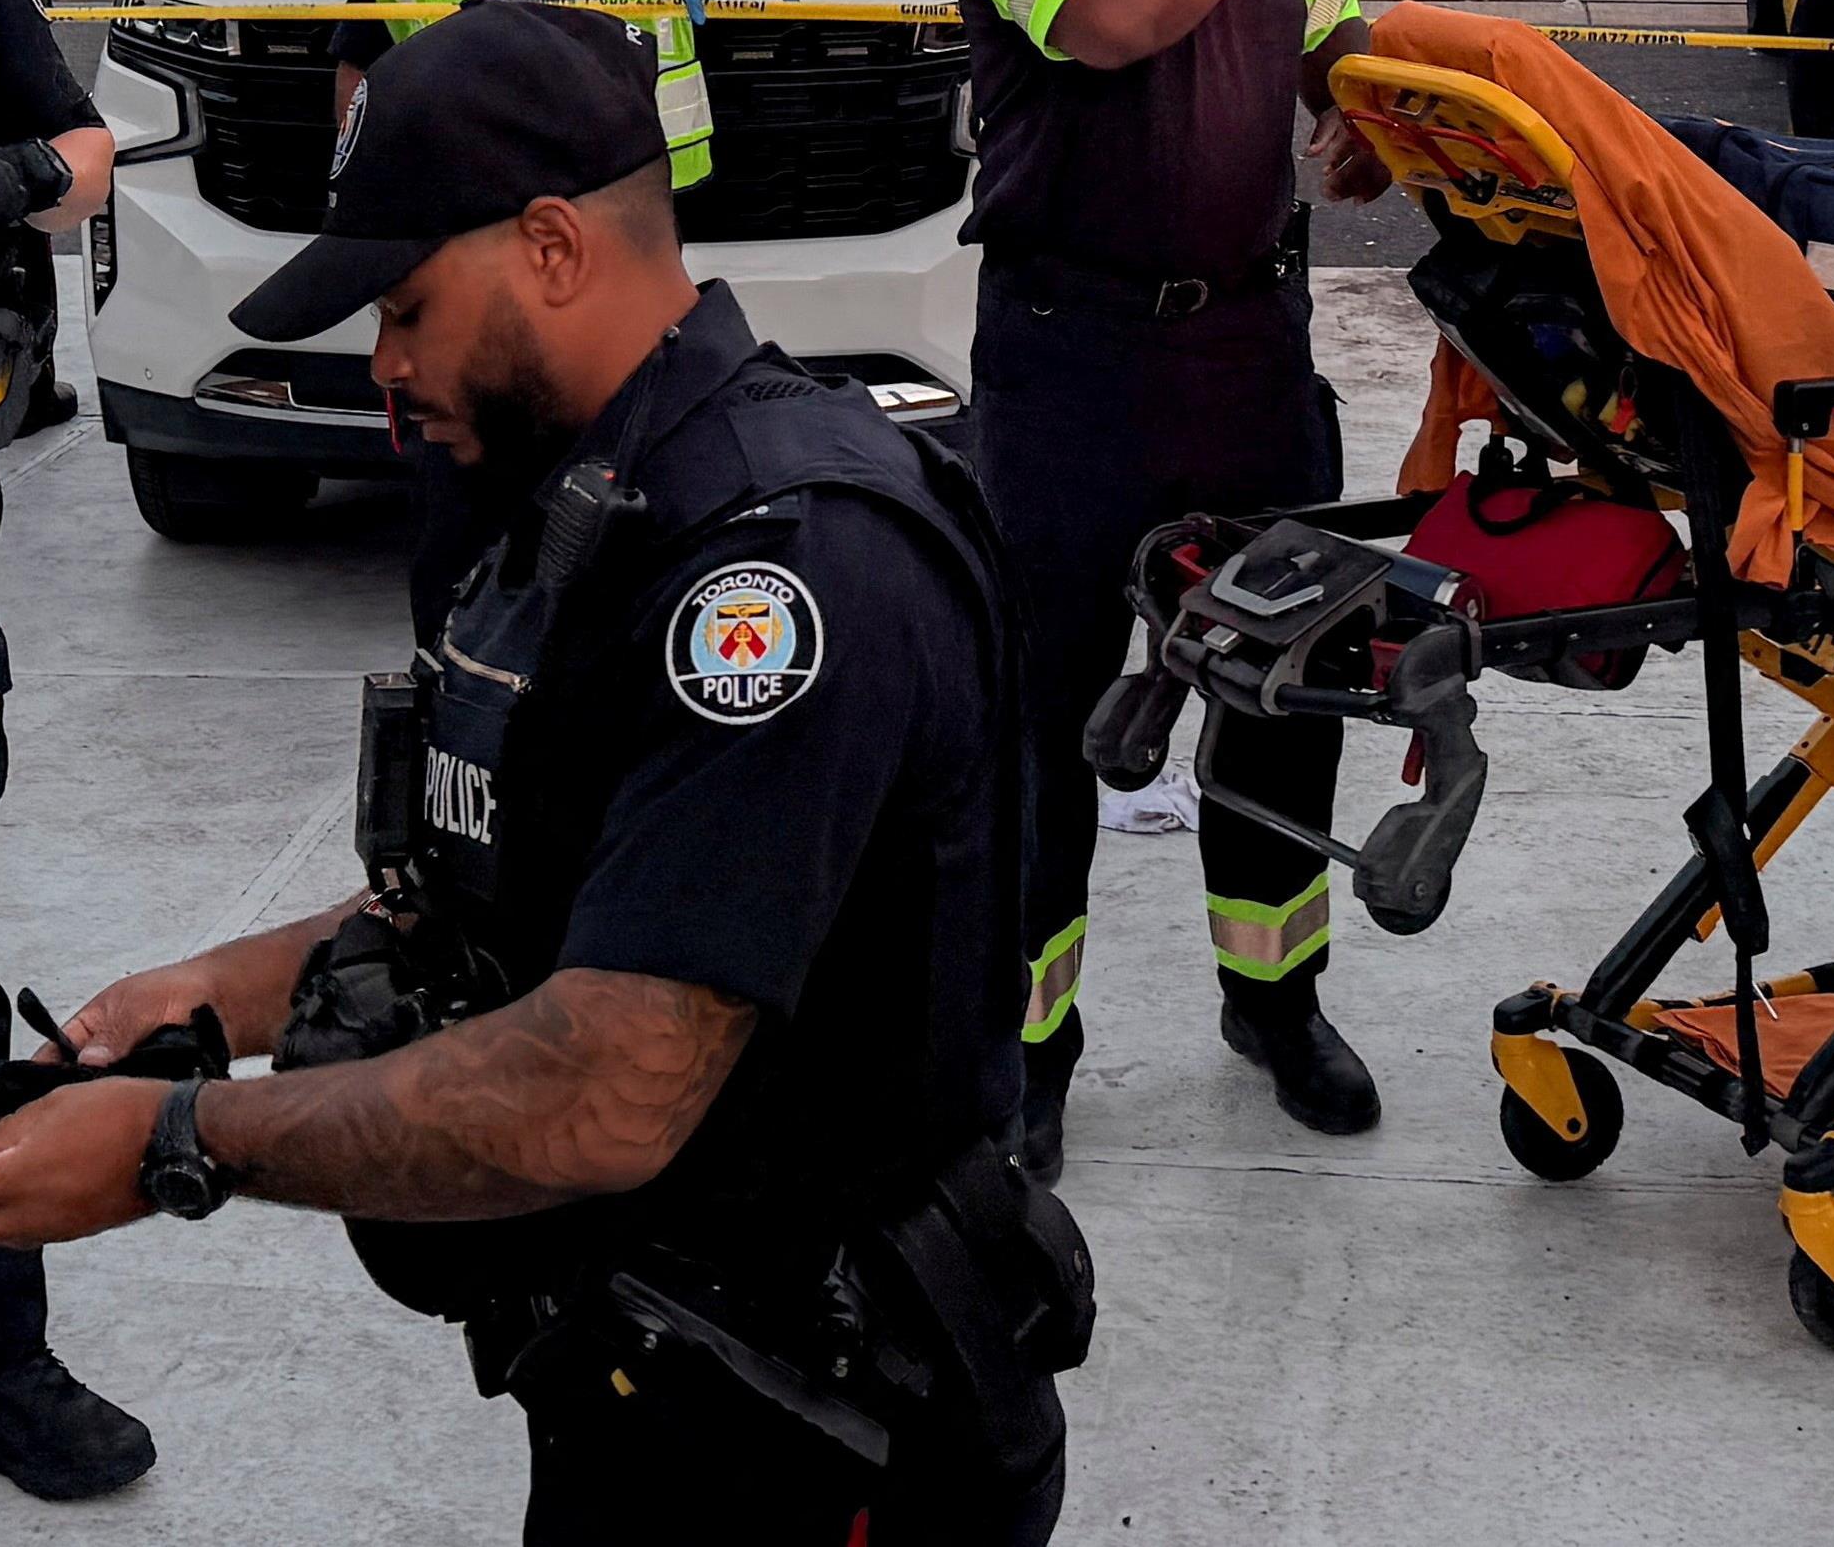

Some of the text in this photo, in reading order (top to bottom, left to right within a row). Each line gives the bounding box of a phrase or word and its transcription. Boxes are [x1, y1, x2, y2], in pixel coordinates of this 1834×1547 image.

[691, 572, 795, 609] TORONTO
[702, 673, 783, 709] POLICE
[424, 746, 498, 846] POLICE
